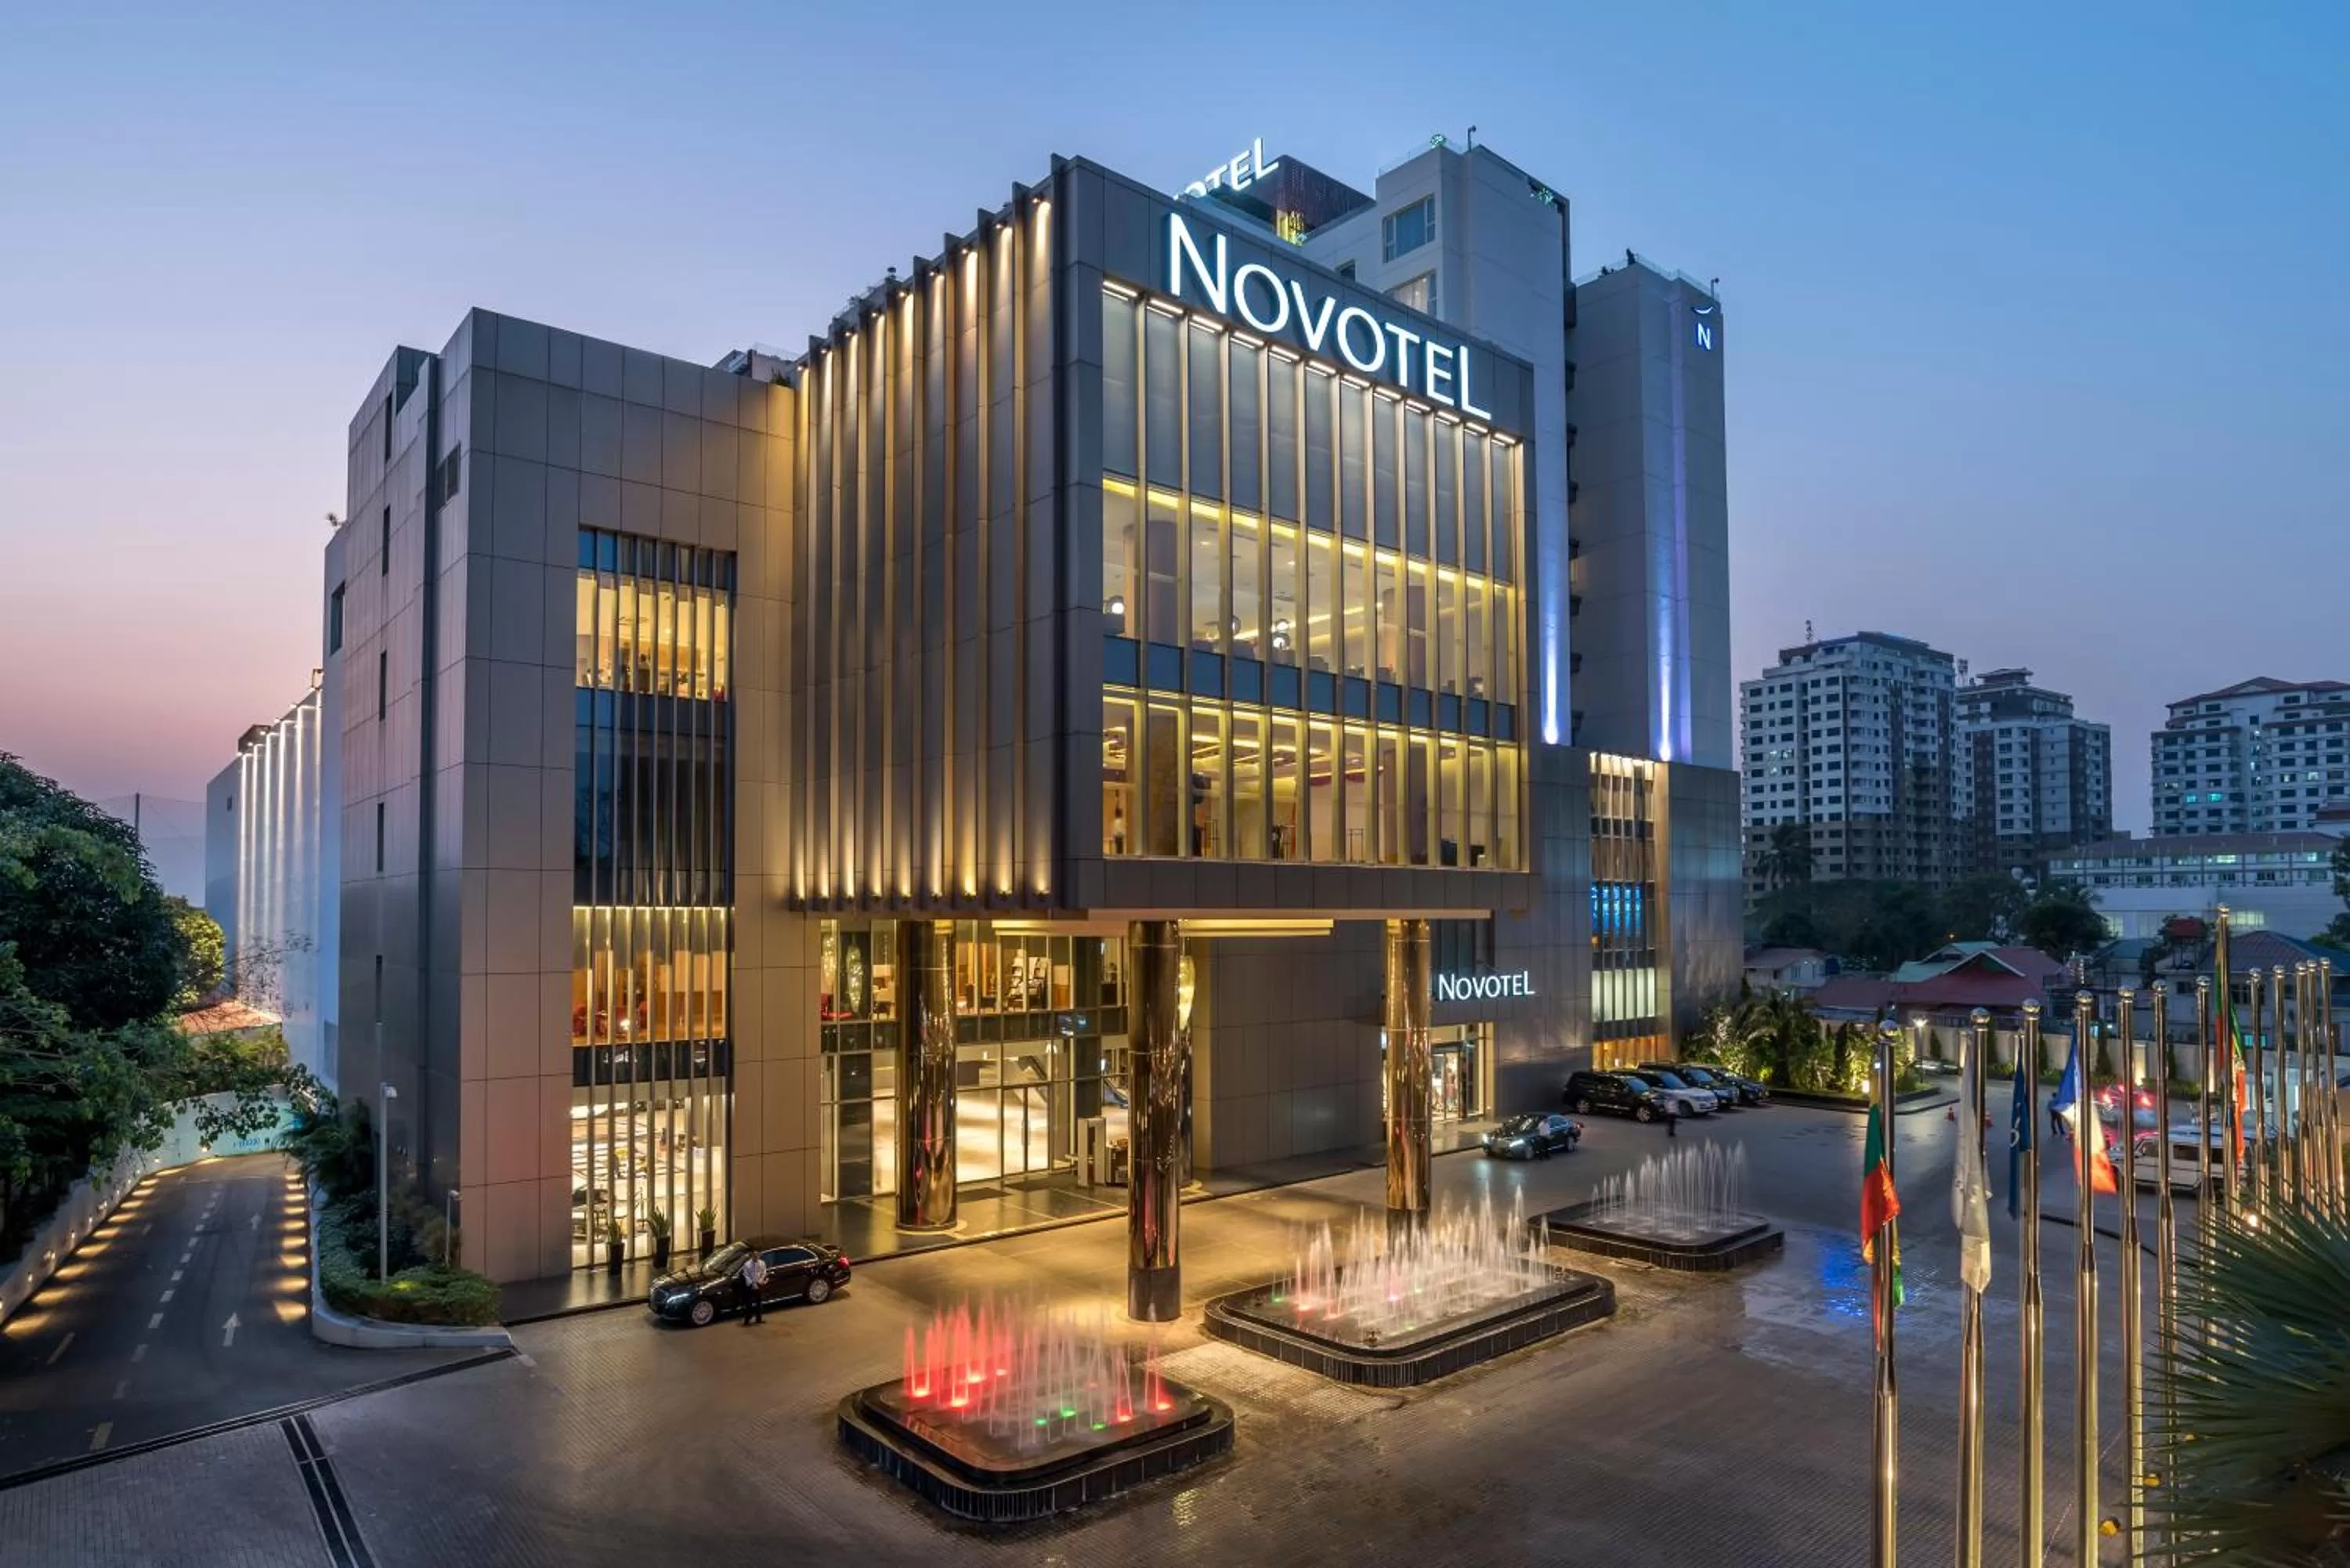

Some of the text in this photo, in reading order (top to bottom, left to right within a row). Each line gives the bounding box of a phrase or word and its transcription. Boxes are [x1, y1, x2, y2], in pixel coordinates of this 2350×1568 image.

[1170, 211, 1491, 421] NOVOTEL
[1697, 322, 1712, 350] N
[1438, 970, 1535, 1001] NOVOTEL
